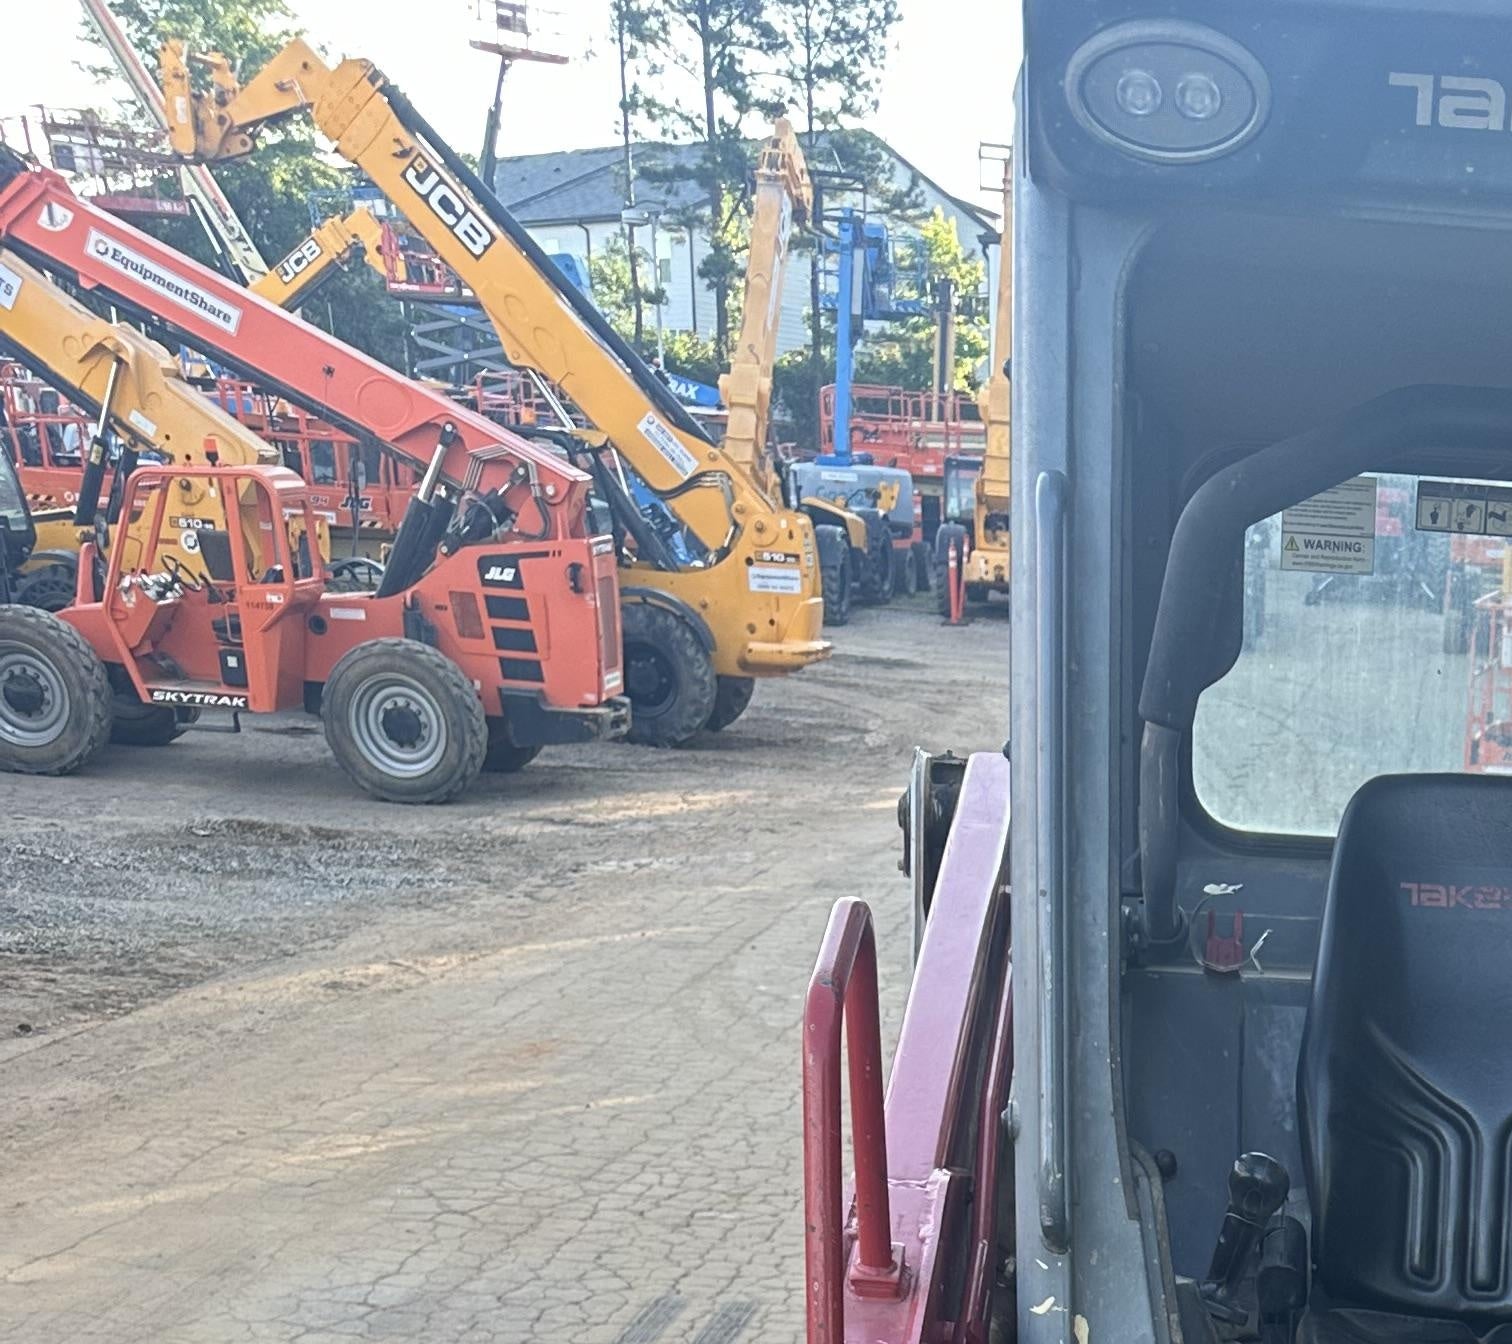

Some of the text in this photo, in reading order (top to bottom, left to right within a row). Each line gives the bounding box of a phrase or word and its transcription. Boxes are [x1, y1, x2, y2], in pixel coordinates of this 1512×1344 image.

[404, 163, 492, 257] JCB
[281, 238, 322, 283] JCB
[109, 243, 233, 325] EquipmentShare
[484, 566, 516, 582] JLG
[152, 690, 246, 707] SKYTRAK
